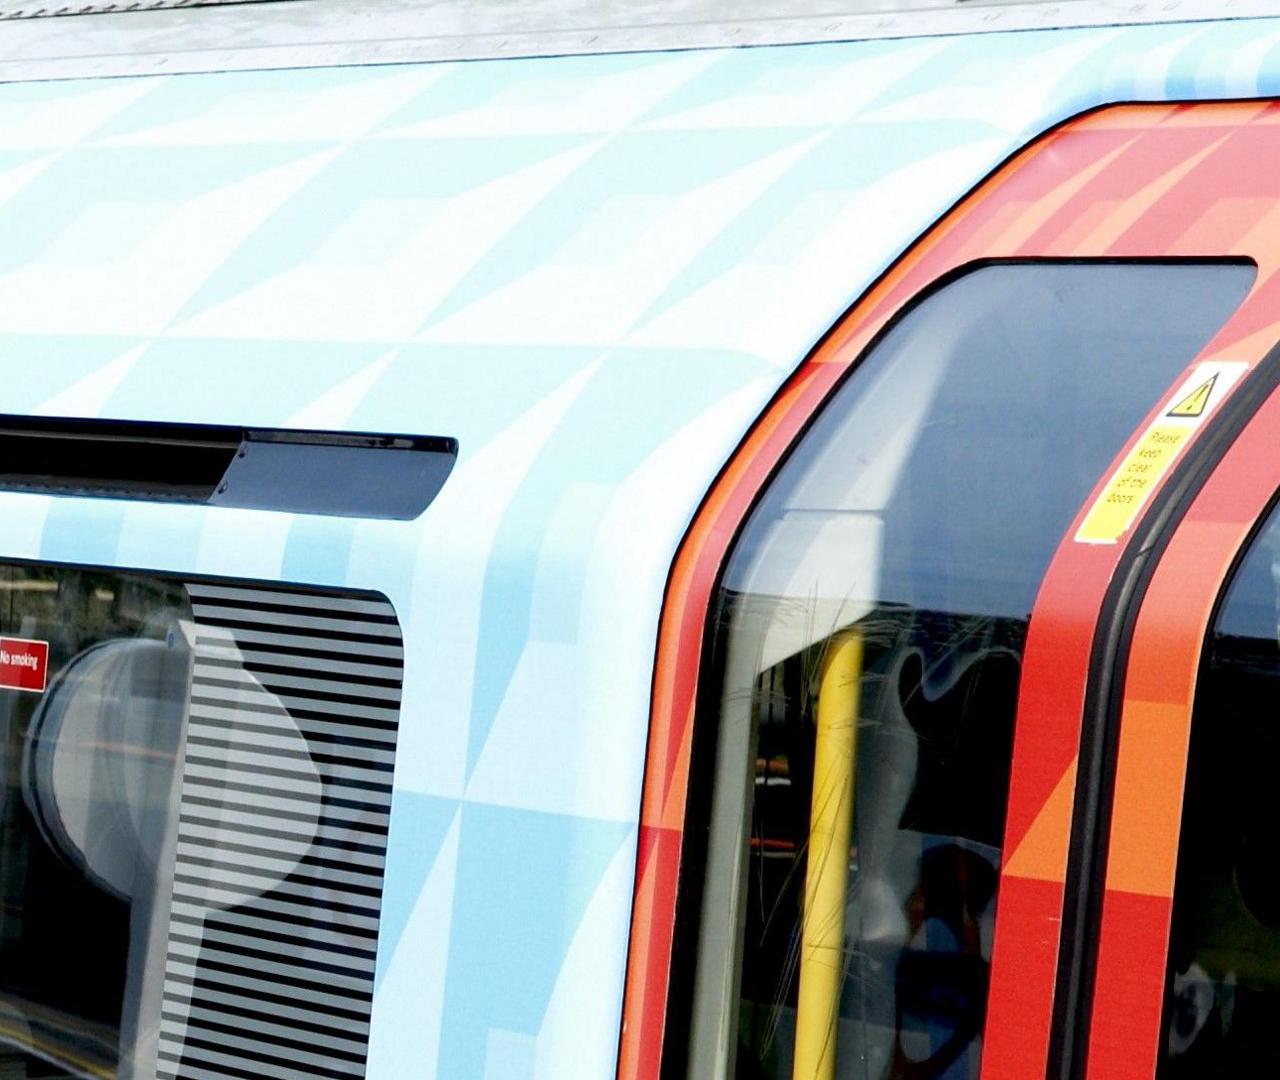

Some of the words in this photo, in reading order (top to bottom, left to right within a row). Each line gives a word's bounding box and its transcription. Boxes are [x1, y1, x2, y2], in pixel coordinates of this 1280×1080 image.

[1152, 431, 1182, 444] Please
[1138, 449, 1162, 459] keep
[1127, 463, 1153, 473] clear
[0, 649, 10, 665] No
[10, 652, 39, 671] smoking
